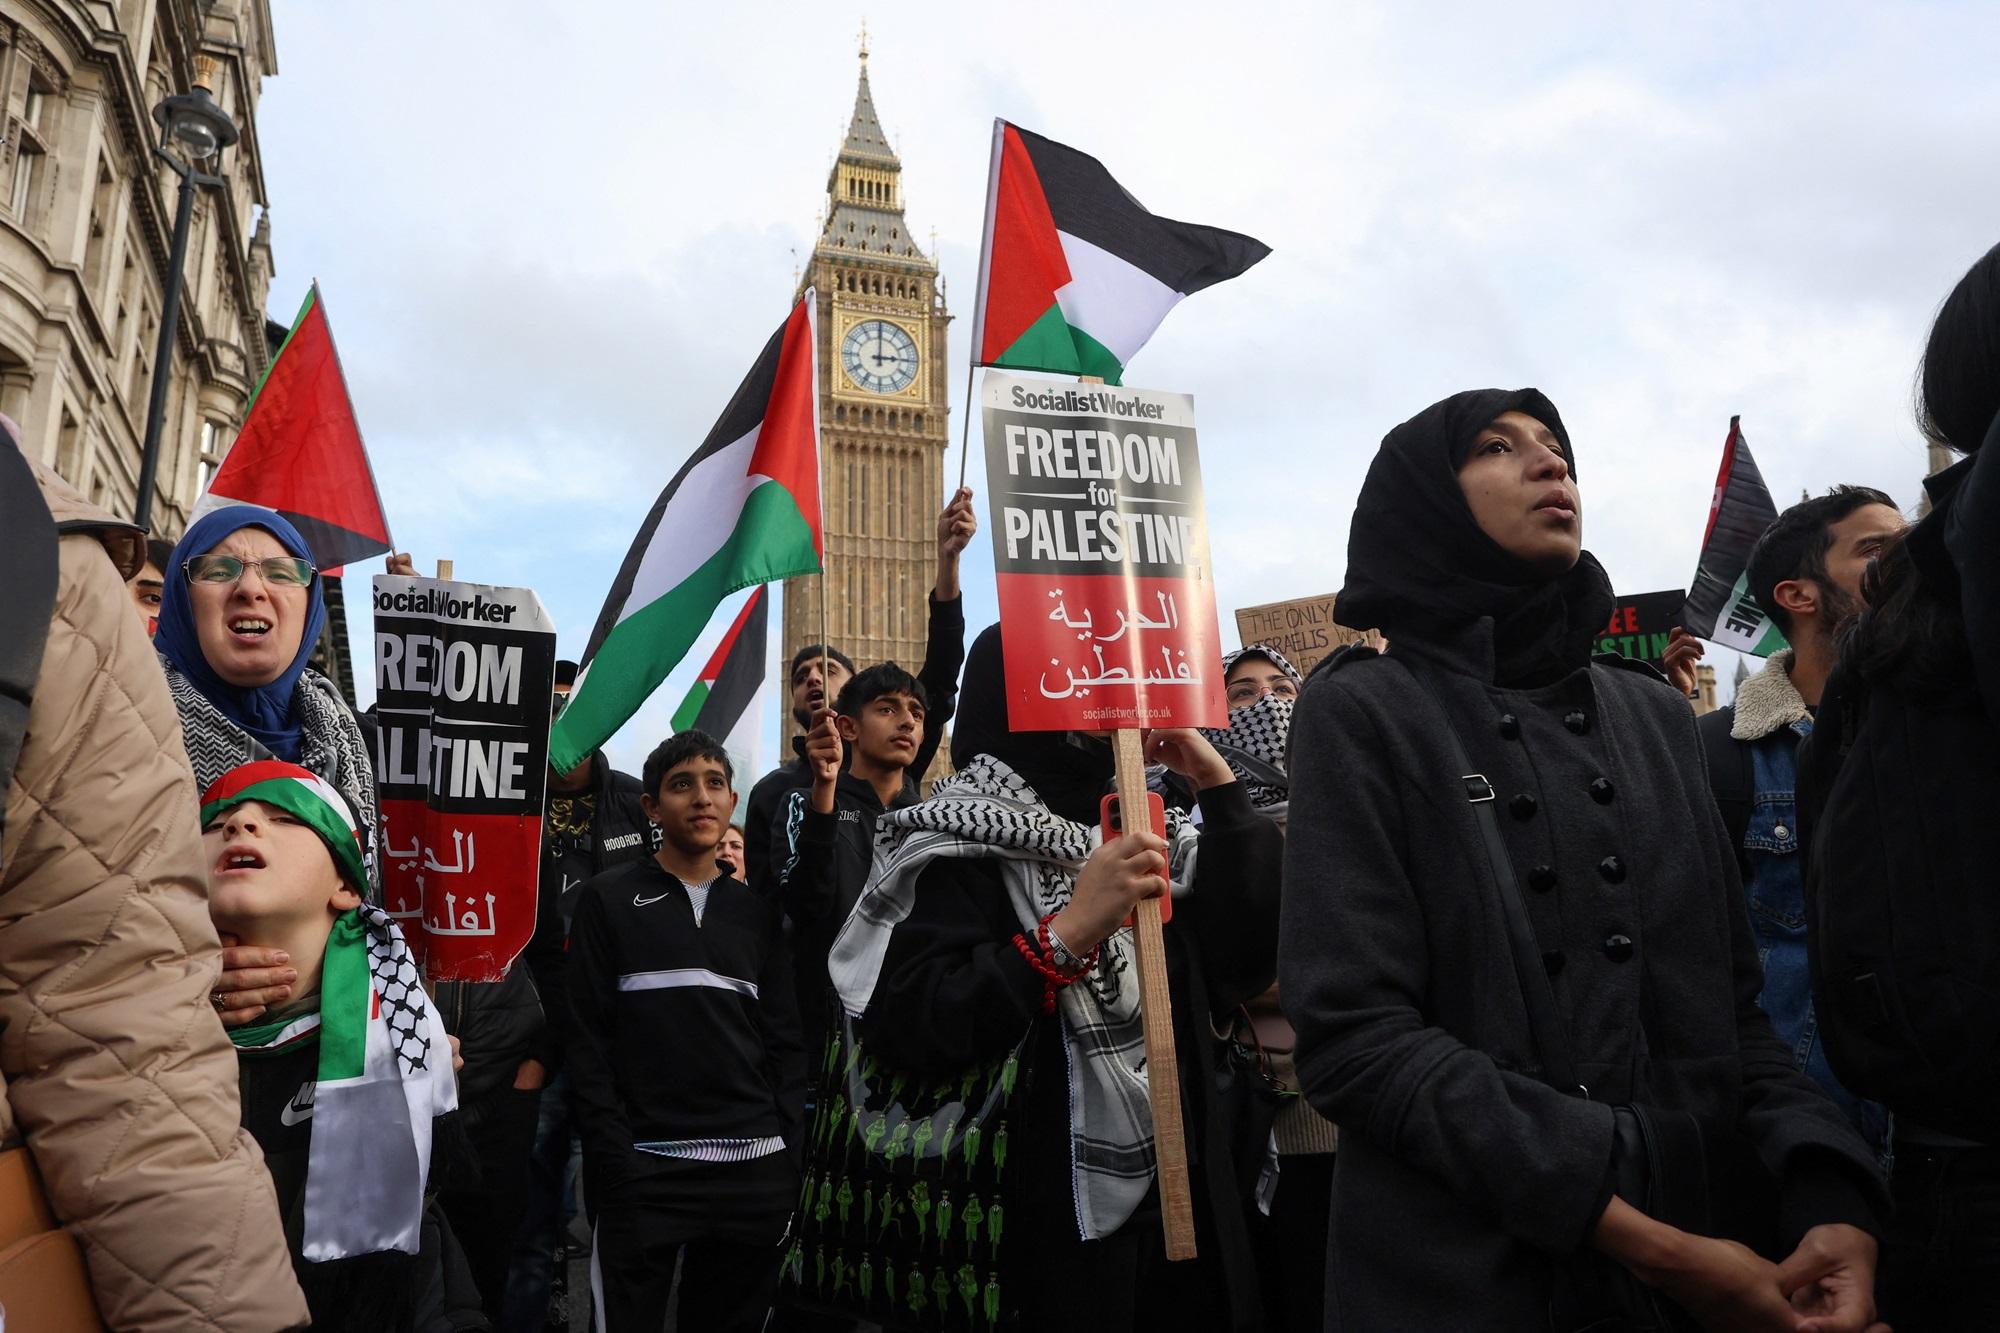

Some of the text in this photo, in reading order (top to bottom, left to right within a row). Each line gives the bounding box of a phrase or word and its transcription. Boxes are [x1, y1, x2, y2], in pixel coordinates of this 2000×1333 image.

[1004, 424, 1182, 486] FREEDOM
[1088, 481, 1119, 506] for
[1049, 588, 1178, 642] الحرية
[1248, 602, 1330, 634] THE ONLY
[603, 832, 643, 852] HOODRICH
